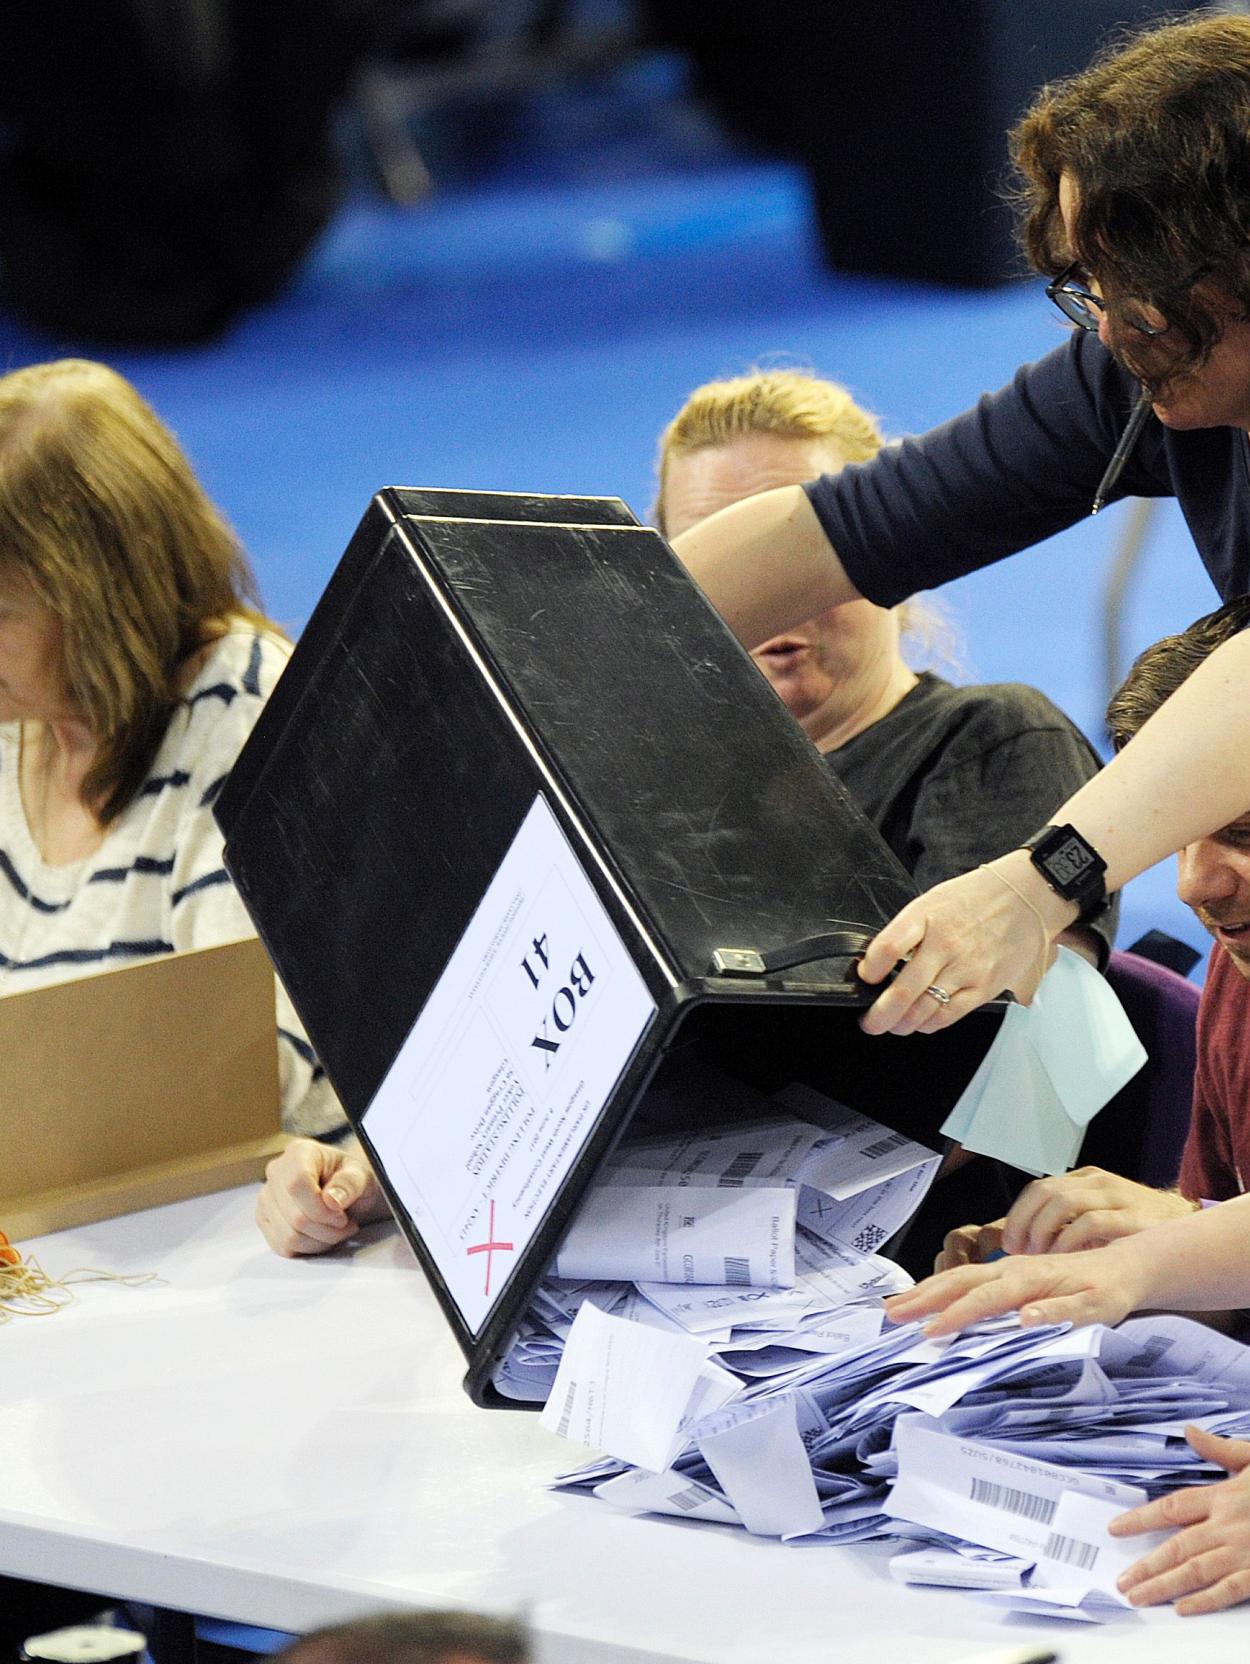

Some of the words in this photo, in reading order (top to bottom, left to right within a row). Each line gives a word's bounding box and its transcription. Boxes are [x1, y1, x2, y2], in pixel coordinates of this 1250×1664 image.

[519, 932, 549, 991] 41
[529, 947, 597, 1072] BOX
[497, 1086, 525, 1133] POLLING
[508, 1107, 535, 1150] POLLING
[472, 1132, 499, 1175] STATION
[482, 1152, 510, 1199] DISTRICT
[771, 1216, 780, 1241] Ballot
[768, 1242, 779, 1269] Paper
